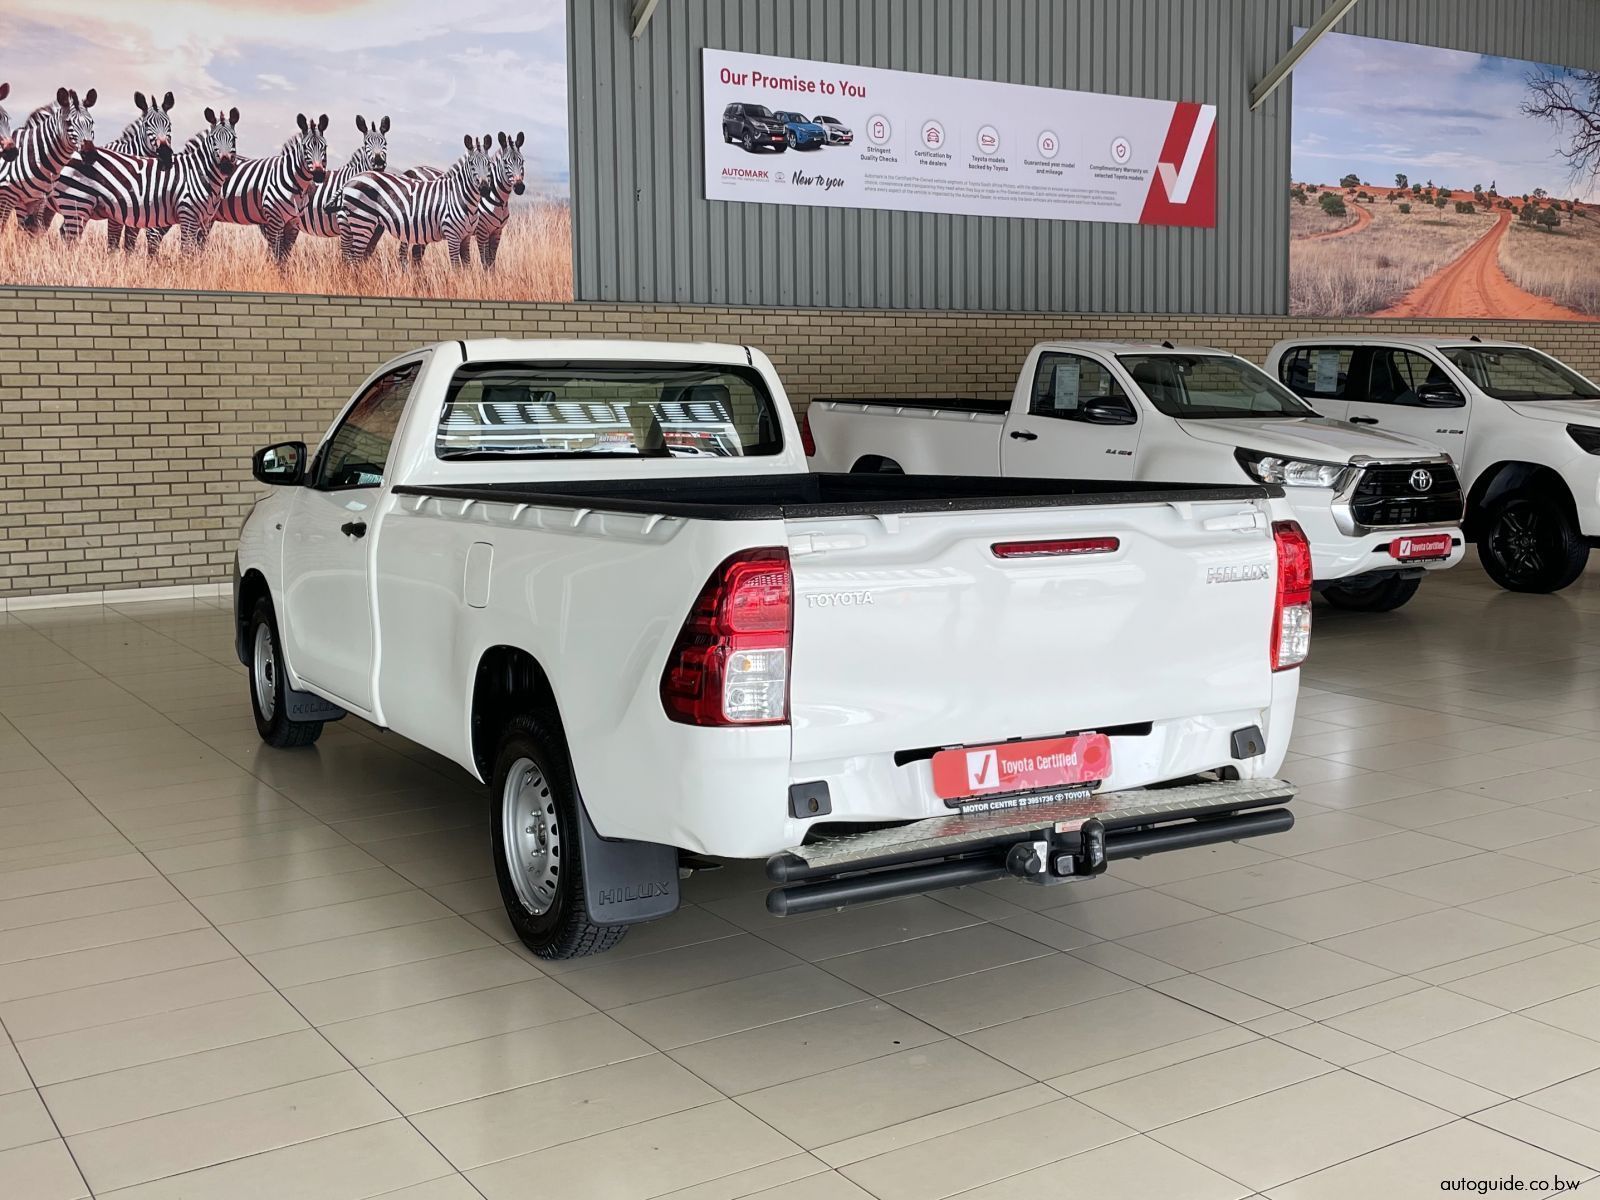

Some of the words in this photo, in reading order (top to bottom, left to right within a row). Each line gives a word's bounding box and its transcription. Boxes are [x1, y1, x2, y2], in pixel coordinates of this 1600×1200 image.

[720, 68, 748, 86] Our
[752, 71, 816, 92] Promise
[820, 80, 834, 94] to
[839, 81, 866, 98] You
[914, 150, 945, 159] Certification
[722, 168, 768, 178] AUTOMARK
[1090, 164, 1122, 173] Complimentary
[792, 170, 814, 186] New
[815, 174, 824, 186] to
[825, 178, 844, 191] you
[1412, 544, 1425, 552] Toyota
[1206, 563, 1270, 584] HILUX
[805, 591, 874, 608] TOYOTA
[1002, 758, 1034, 774] Toyota
[1037, 752, 1077, 769] Certified
[963, 803, 988, 813] MOTOR
[990, 800, 1017, 810] CENTRE
[1064, 790, 1091, 800] TOYOTA
[599, 881, 670, 905] HILUX
